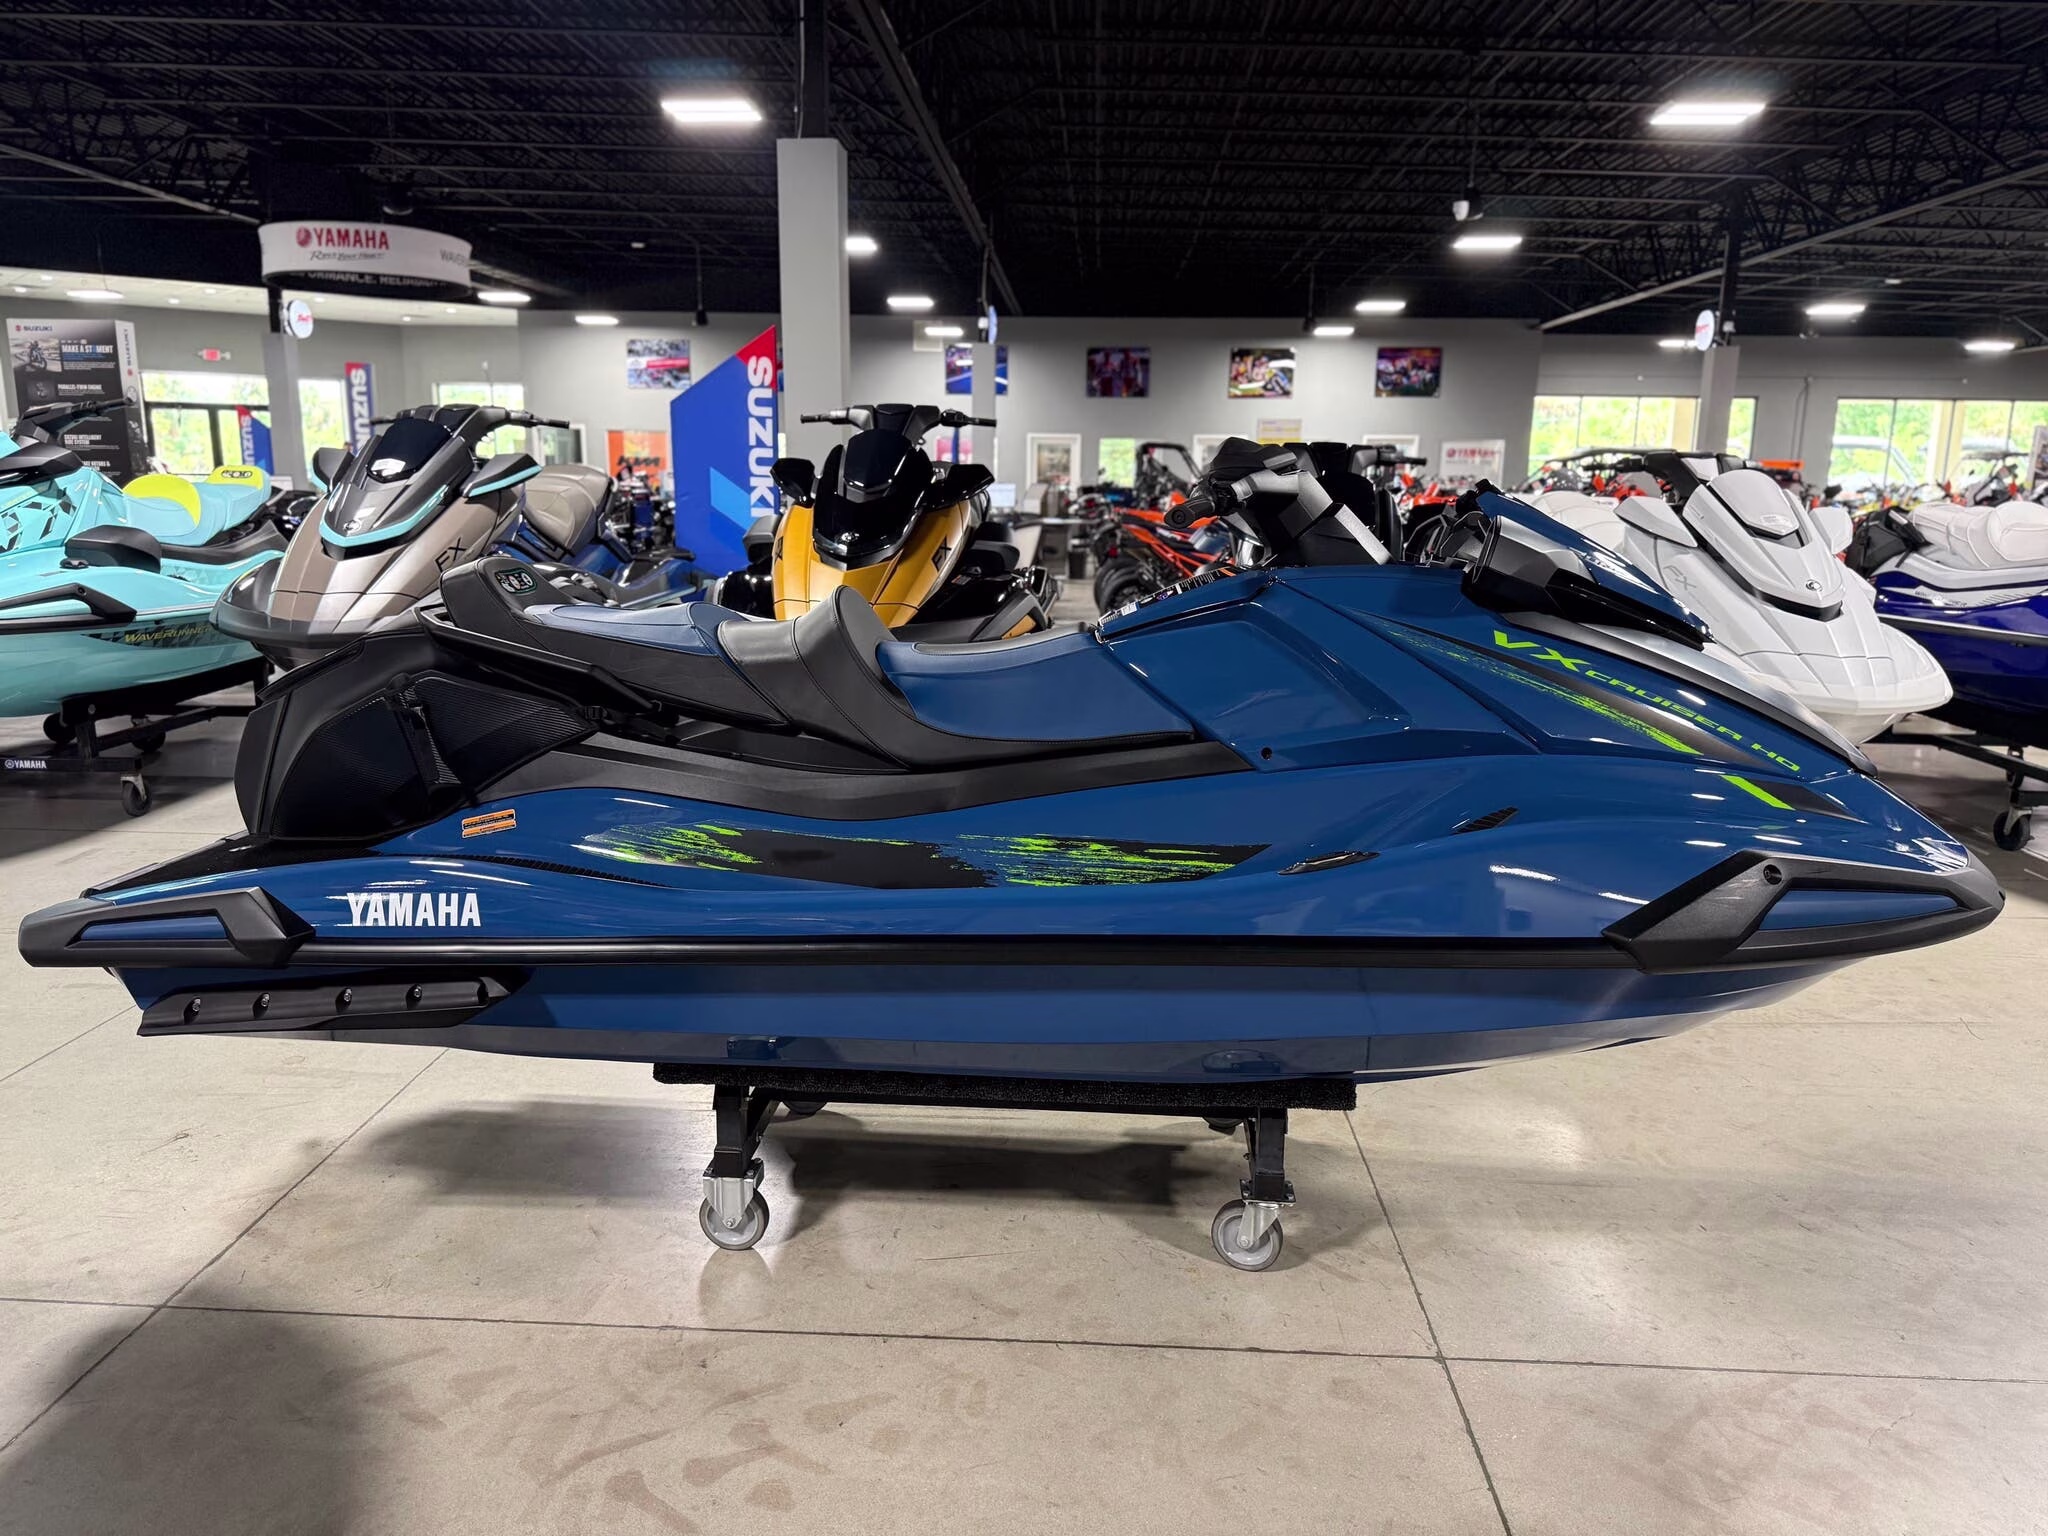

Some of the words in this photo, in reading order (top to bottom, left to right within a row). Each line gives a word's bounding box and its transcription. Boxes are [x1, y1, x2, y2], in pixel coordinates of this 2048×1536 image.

[313, 227, 390, 250] YAMAHA
[747, 355, 775, 518] SUZUKI
[434, 536, 467, 573] FX
[931, 535, 952, 572] FX
[1663, 564, 1697, 591] FX
[1493, 629, 1590, 672] VX
[1585, 669, 1743, 741] CRUISER
[1751, 743, 1800, 772] HO
[14, 759, 47, 769] YAMAHA
[346, 892, 482, 927] YAMAHA
